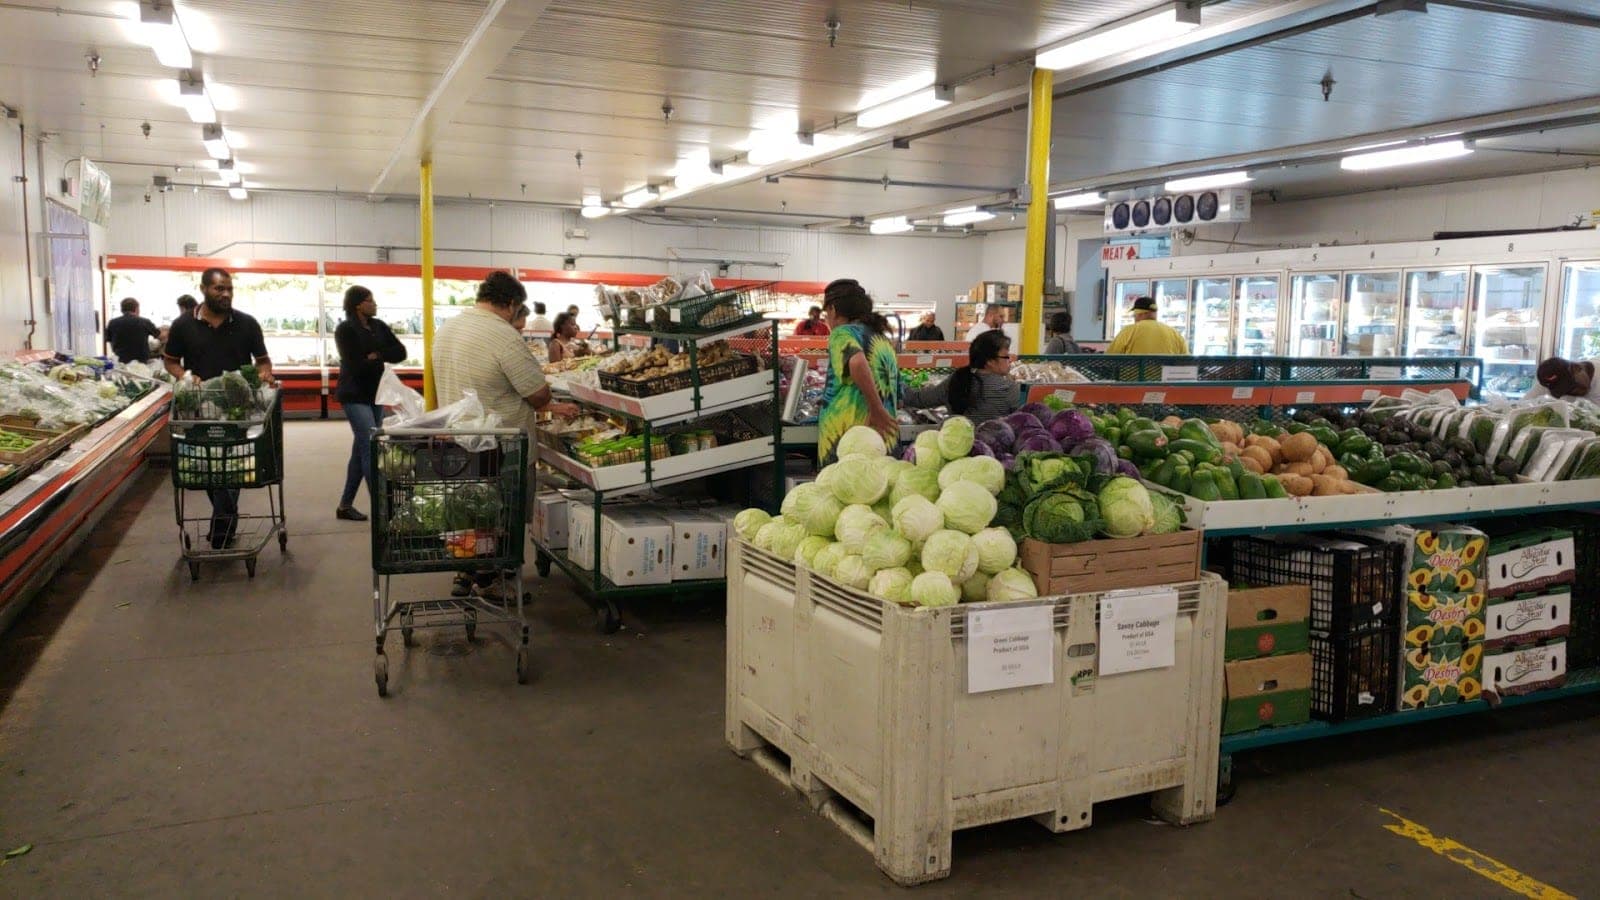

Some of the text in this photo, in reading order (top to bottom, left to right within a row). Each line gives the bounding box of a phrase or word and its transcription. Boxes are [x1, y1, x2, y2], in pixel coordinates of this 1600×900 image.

[1434, 247, 1440, 256] 7
[1508, 243, 1514, 252] 8
[1102, 246, 1125, 260] MEAT
[1312, 253, 1318, 262] 5
[1117, 619, 1160, 631] Savoy Cabbage
[1121, 632, 1139, 640] Product
[993, 646, 1010, 654] Product
